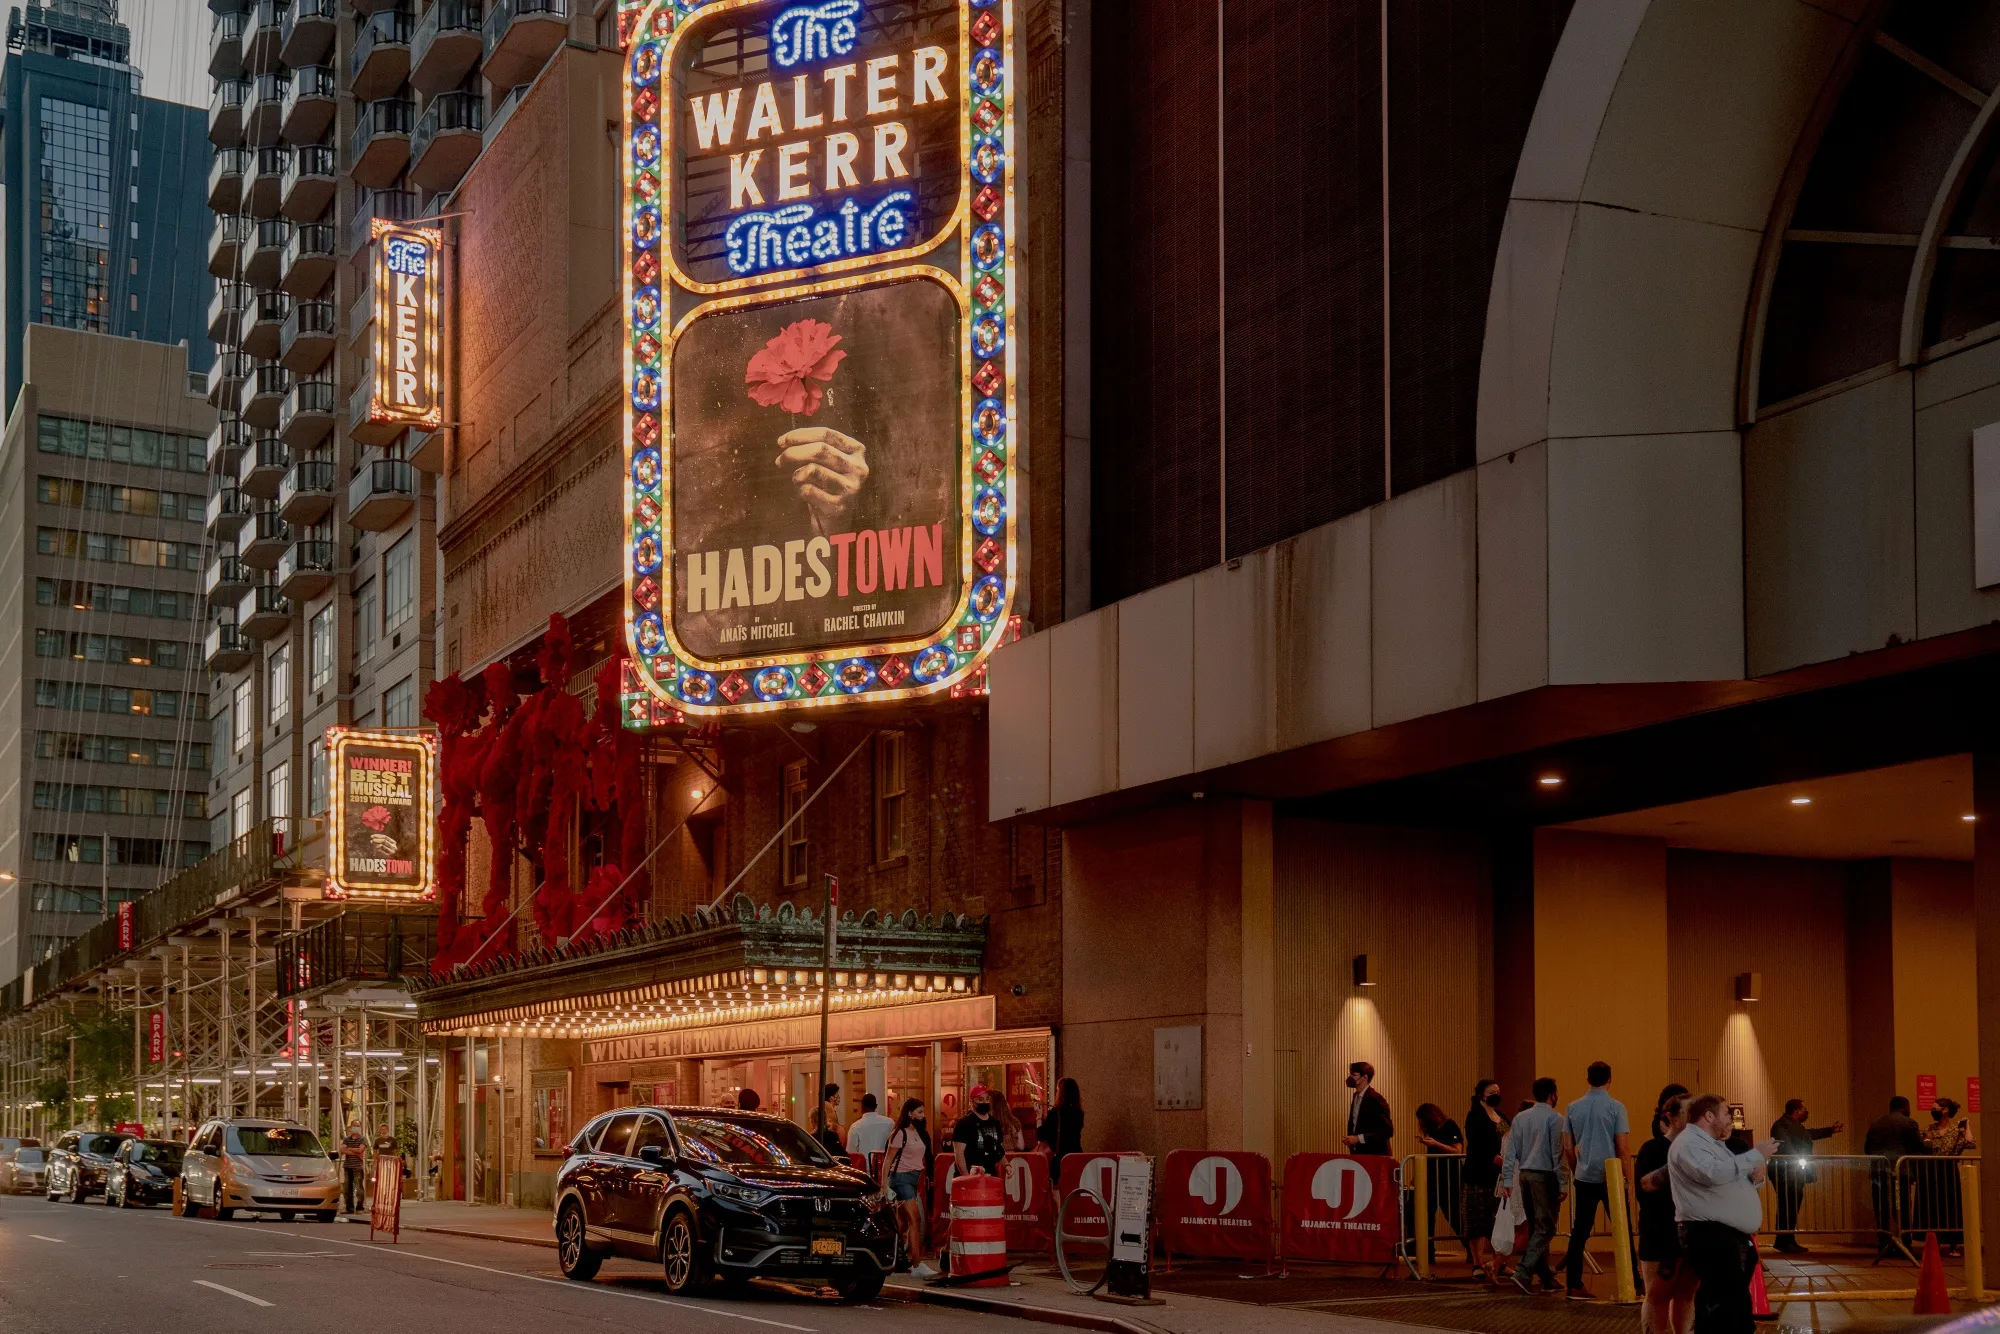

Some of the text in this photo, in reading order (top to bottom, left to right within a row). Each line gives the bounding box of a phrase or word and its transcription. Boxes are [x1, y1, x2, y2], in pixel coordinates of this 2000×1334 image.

[772, 0, 860, 67] The
[690, 46, 950, 150] WALTER
[728, 122, 909, 210] KERR
[726, 191, 911, 274] Theatre
[388, 240, 426, 275] The
[396, 273, 419, 406] KERR
[687, 524, 943, 613] HADESTOWN
[852, 604, 871, 612] DIRECTED
[720, 622, 795, 643] ANAÏS MITCHELL
[824, 610, 905, 632] RACHEL CHAVKIN
[350, 757, 412, 773] WINNER!
[350, 769, 412, 784] BEST
[350, 781, 412, 798] MUSICAL
[350, 795, 412, 806] 2019 TONY AWARD
[350, 858, 412, 874] HADESTOWN
[122, 913, 130, 941] PARK
[153, 1023, 161, 1053] PARK
[590, 1035, 678, 1062] WINNER!
[694, 1029, 729, 1053] TONY
[728, 1022, 787, 1050] AWARDS
[828, 1014, 877, 1042] BEST
[885, 1001, 989, 1037] MUSICAL
[1180, 1216, 1252, 1227] JUJAMCYN THEATERS
[1300, 1219, 1381, 1231] JUJAMCYN THEATERS
